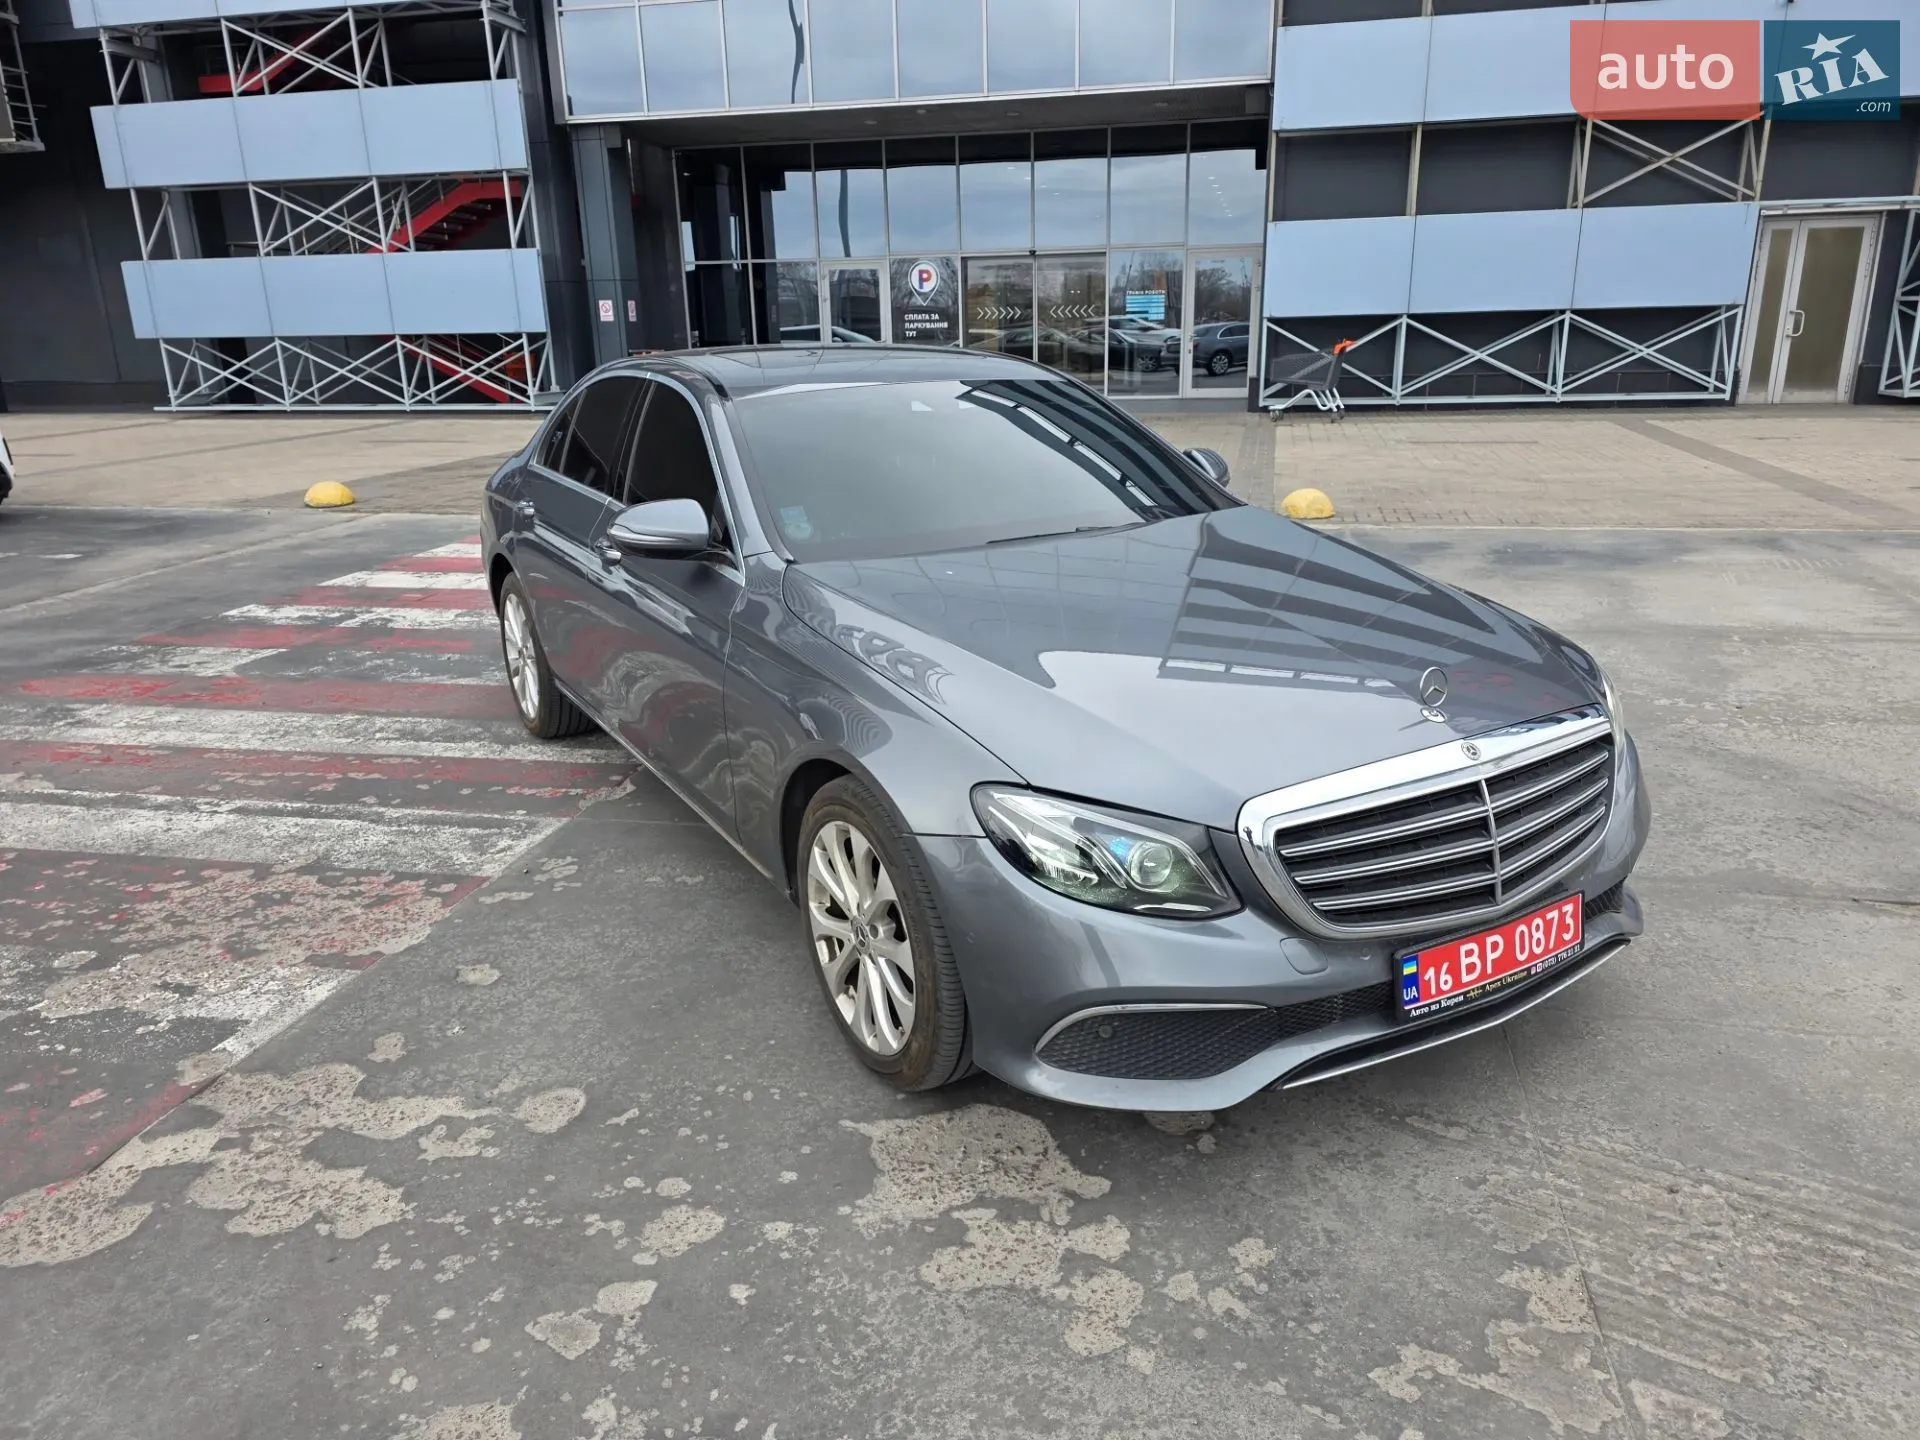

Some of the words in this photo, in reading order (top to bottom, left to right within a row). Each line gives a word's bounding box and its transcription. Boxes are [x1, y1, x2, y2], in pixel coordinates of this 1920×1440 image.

[918, 269, 932, 289] P
[904, 321, 948, 329] ПАРКУВАННЯ
[1423, 961, 1453, 995] 16
[1459, 934, 1504, 984] BP
[1515, 902, 1574, 962] 0873
[1502, 970, 1528, 985] Ukraine
[1403, 986, 1418, 1001] UA
[1409, 1006, 1430, 1018] Авто
[1430, 1003, 1440, 1011] из
